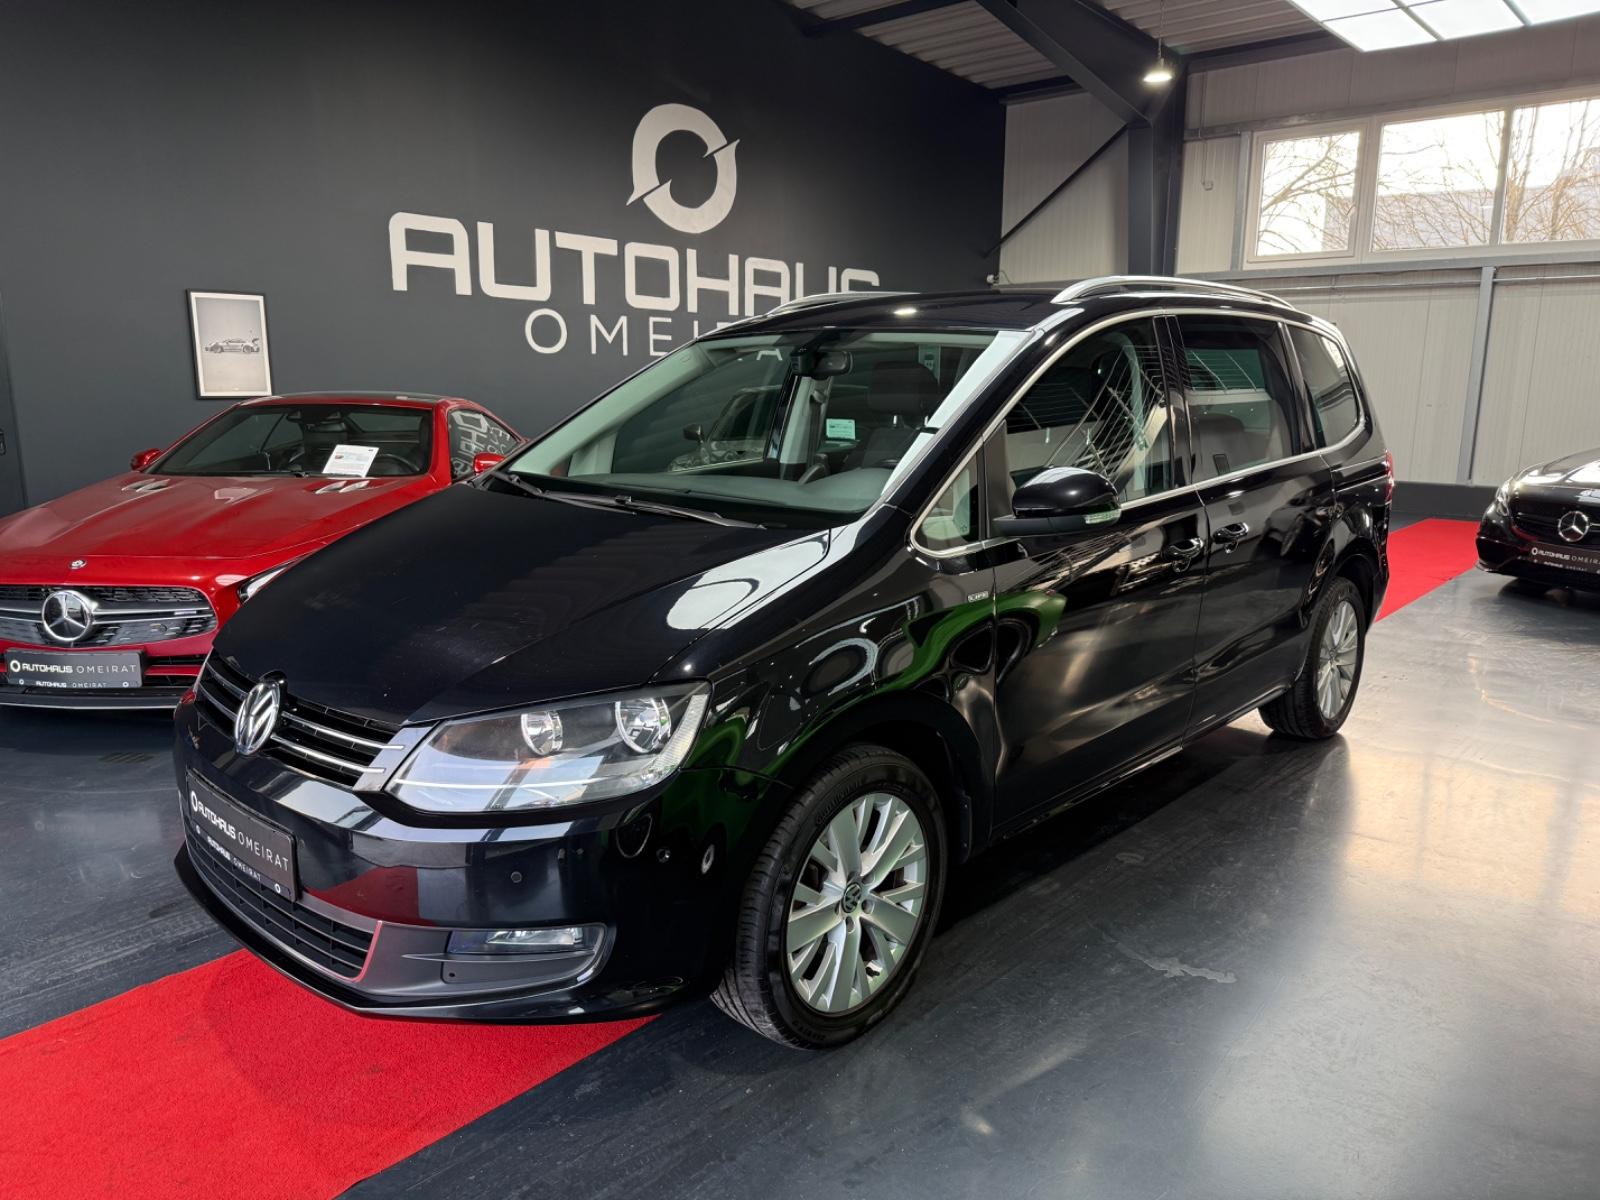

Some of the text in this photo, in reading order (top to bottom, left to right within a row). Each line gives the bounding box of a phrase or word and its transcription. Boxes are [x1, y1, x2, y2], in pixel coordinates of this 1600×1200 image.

[22, 663, 136, 673] AUTOHAUS OMEIRAT
[198, 801, 289, 872] AUTOHAUS OMEIRAT
